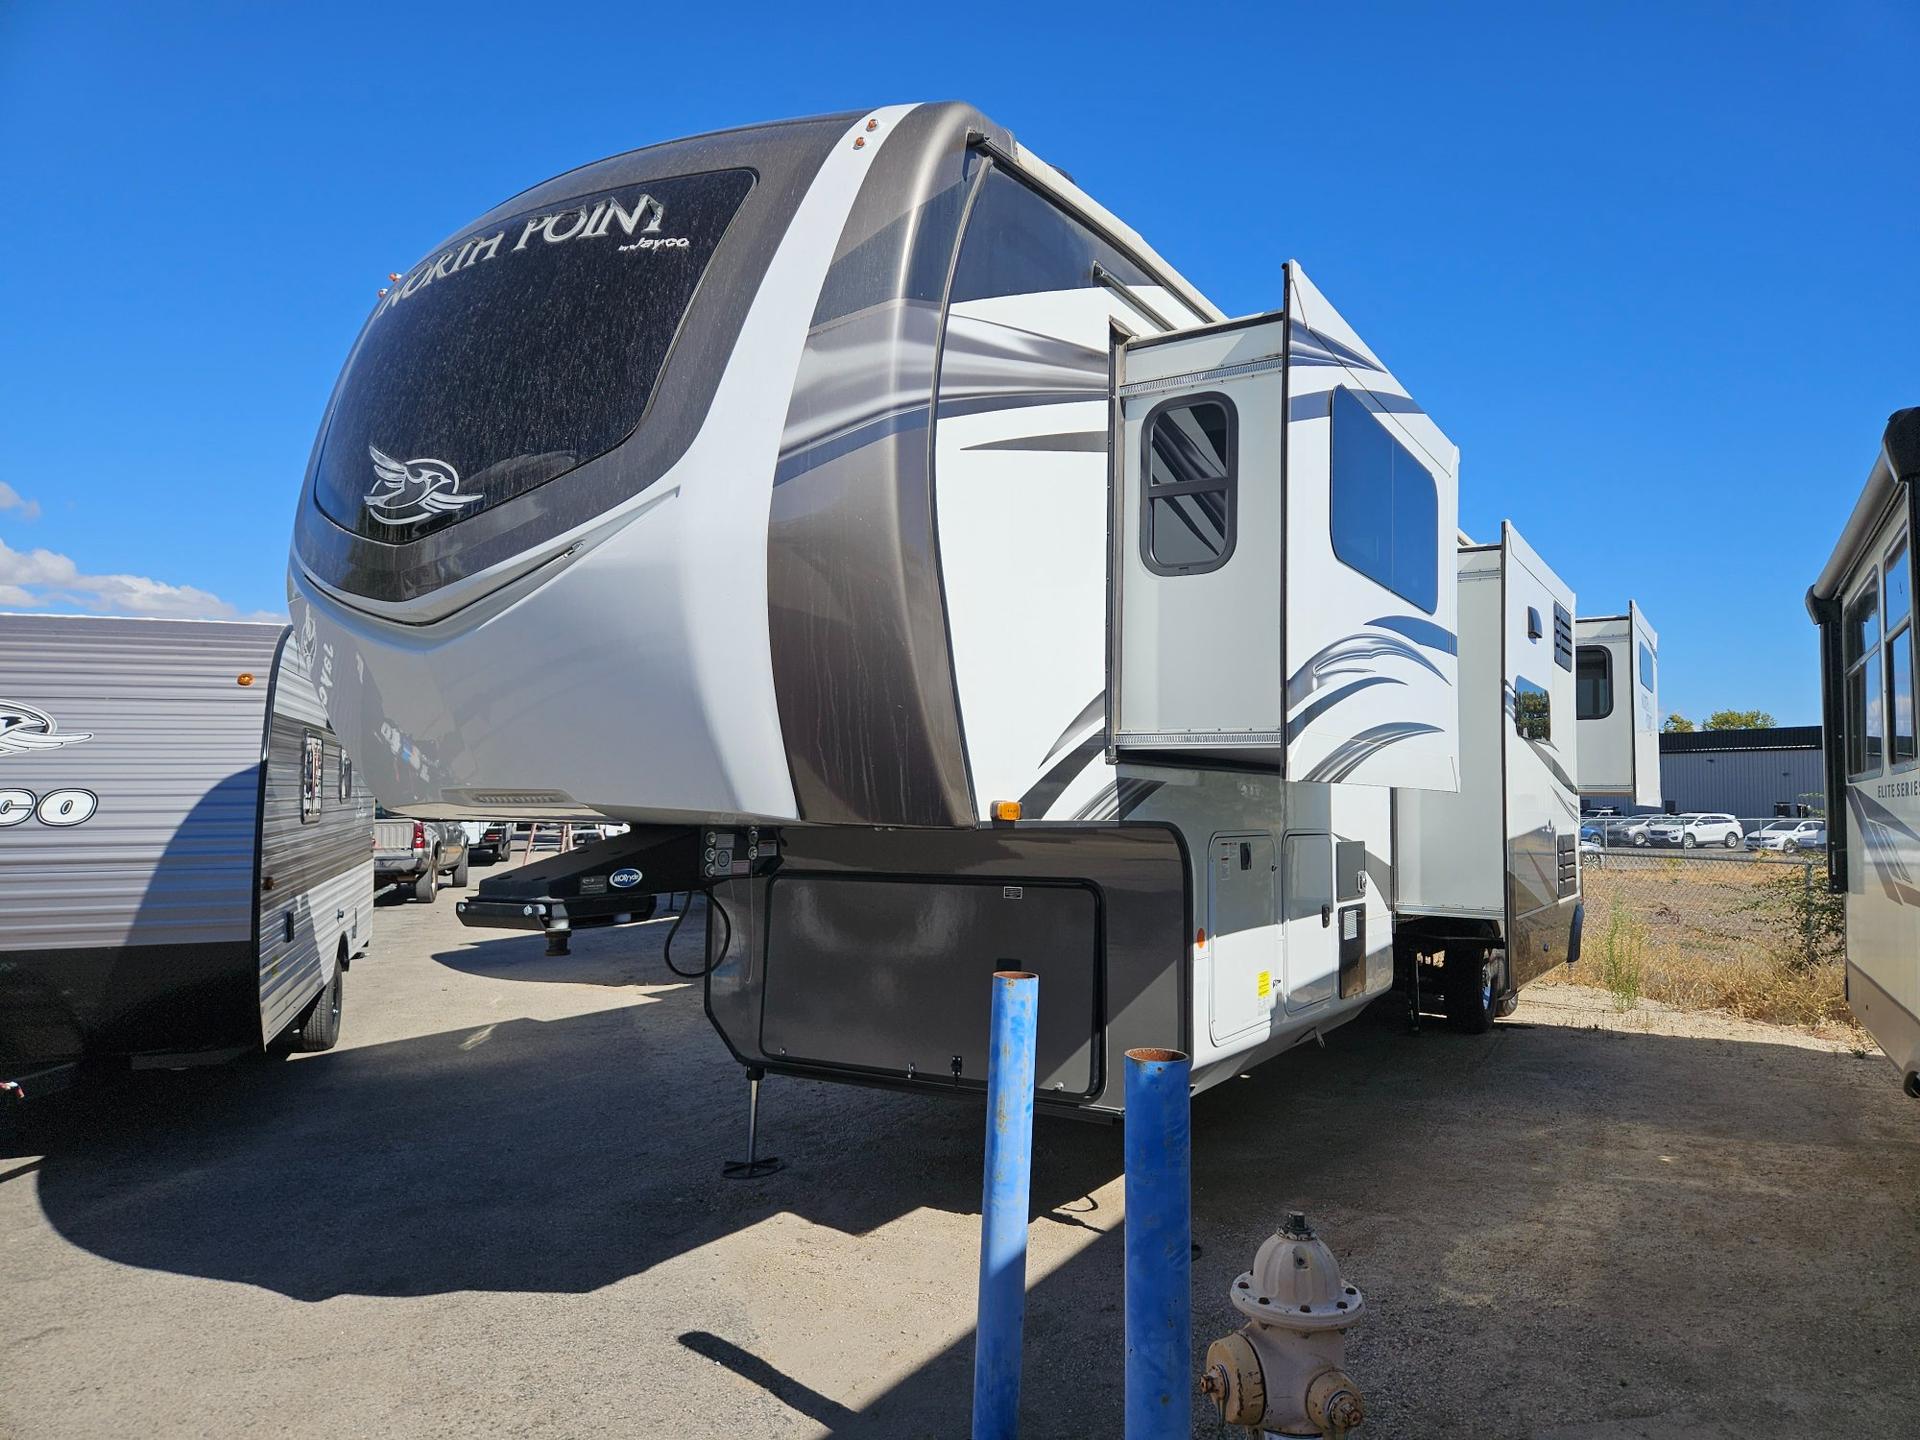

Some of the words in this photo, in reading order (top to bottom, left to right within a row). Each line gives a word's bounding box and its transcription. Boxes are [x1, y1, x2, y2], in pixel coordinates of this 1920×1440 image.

[629, 238, 690, 252] Jayco
[376, 230, 505, 320] NORTH
[511, 194, 664, 252] POINT
[1877, 783, 1895, 798] ELITE
[1896, 780, 1920, 797] SERIE
